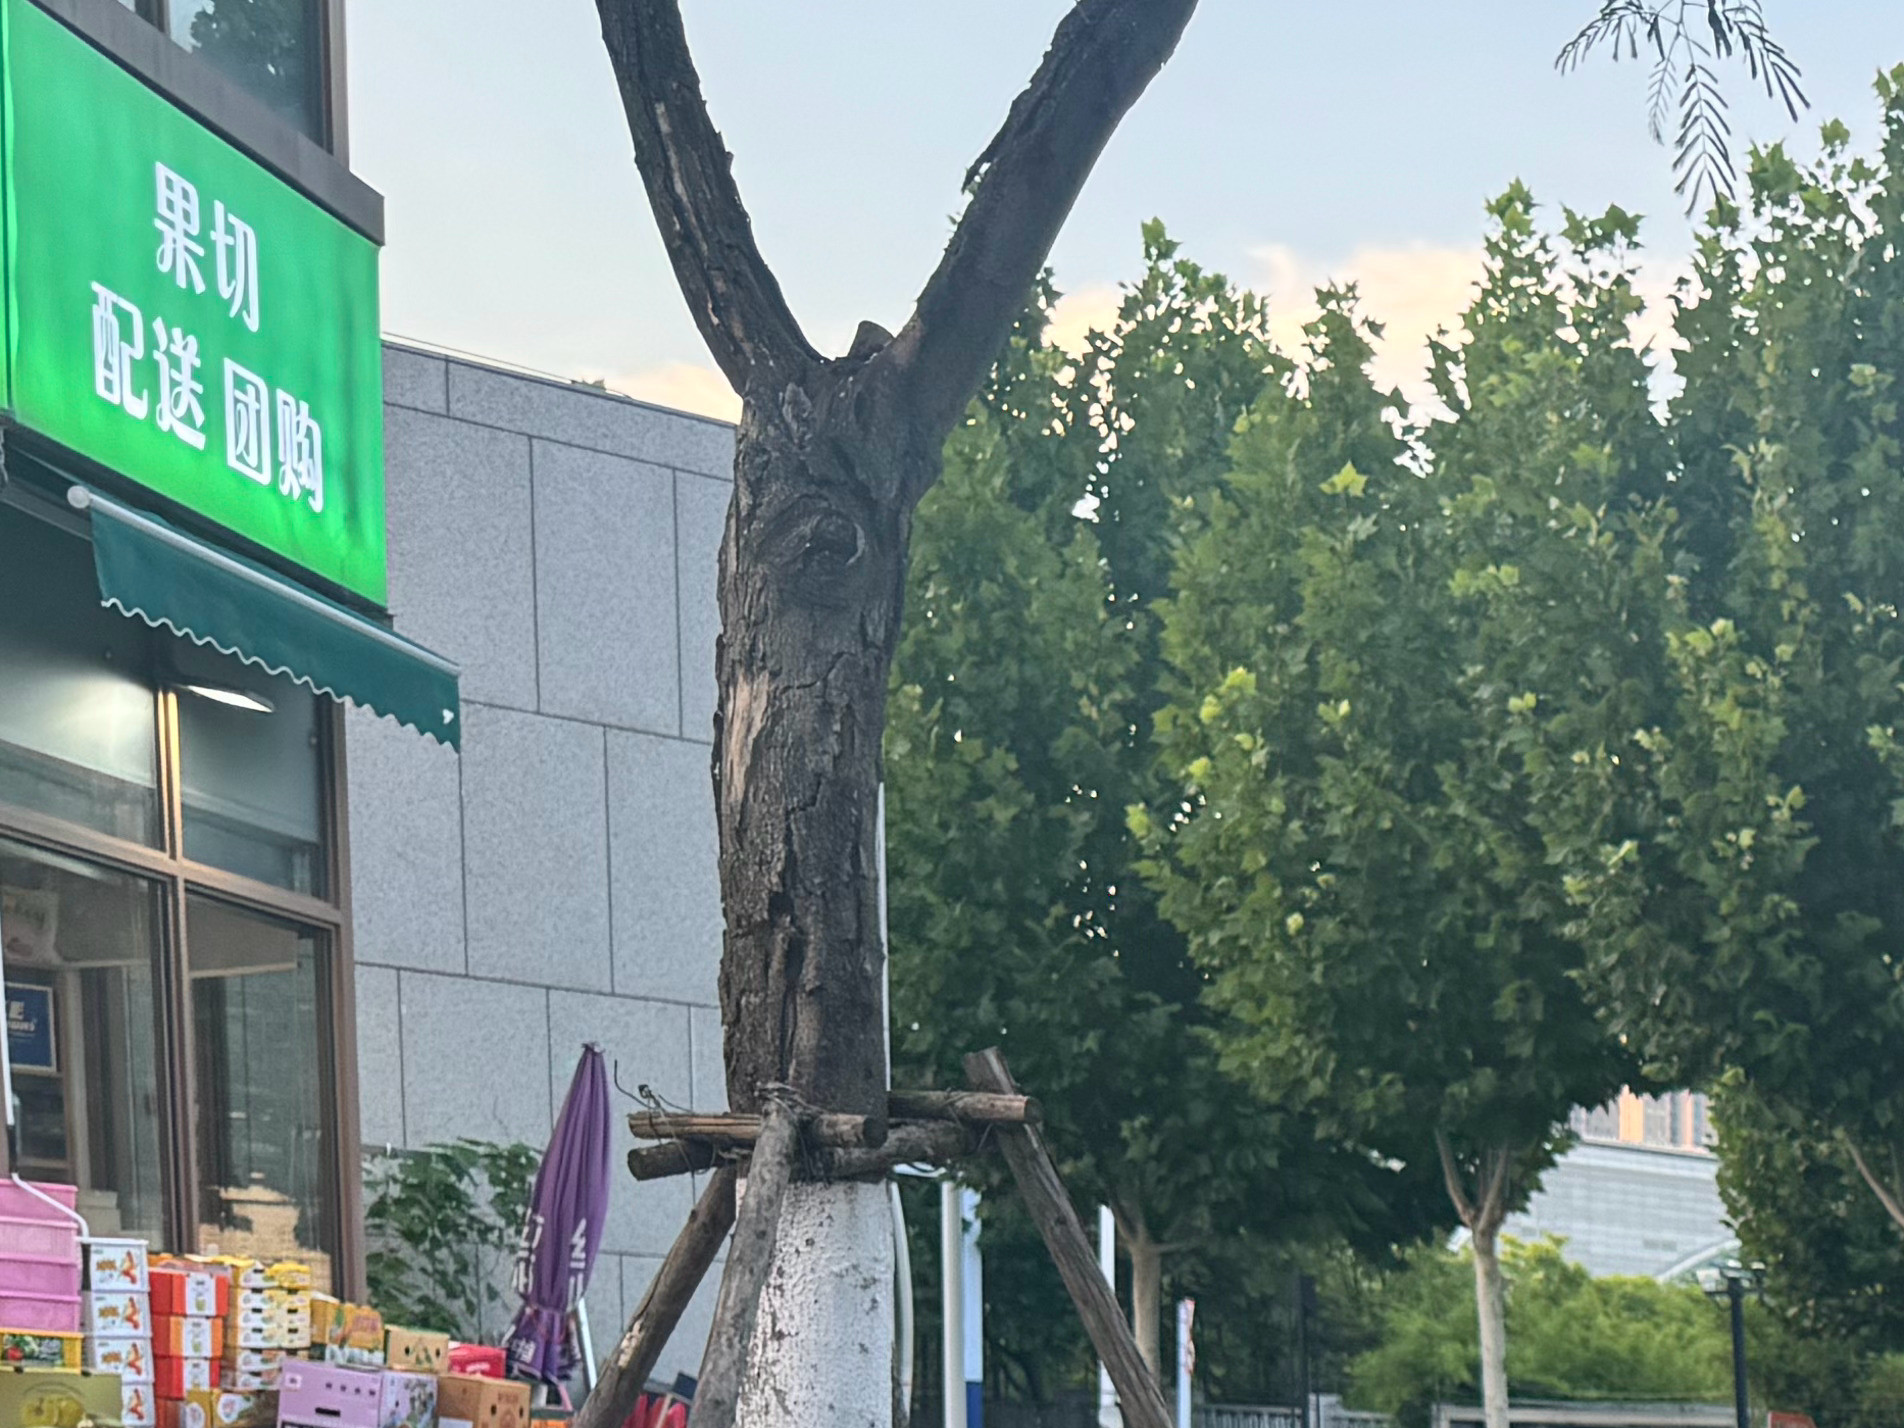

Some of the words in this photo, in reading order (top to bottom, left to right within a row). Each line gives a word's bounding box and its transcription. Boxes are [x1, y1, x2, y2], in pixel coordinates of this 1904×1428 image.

[153, 161, 260, 333] 果切
[91, 280, 206, 451] 配送
[223, 357, 325, 514] 团购
